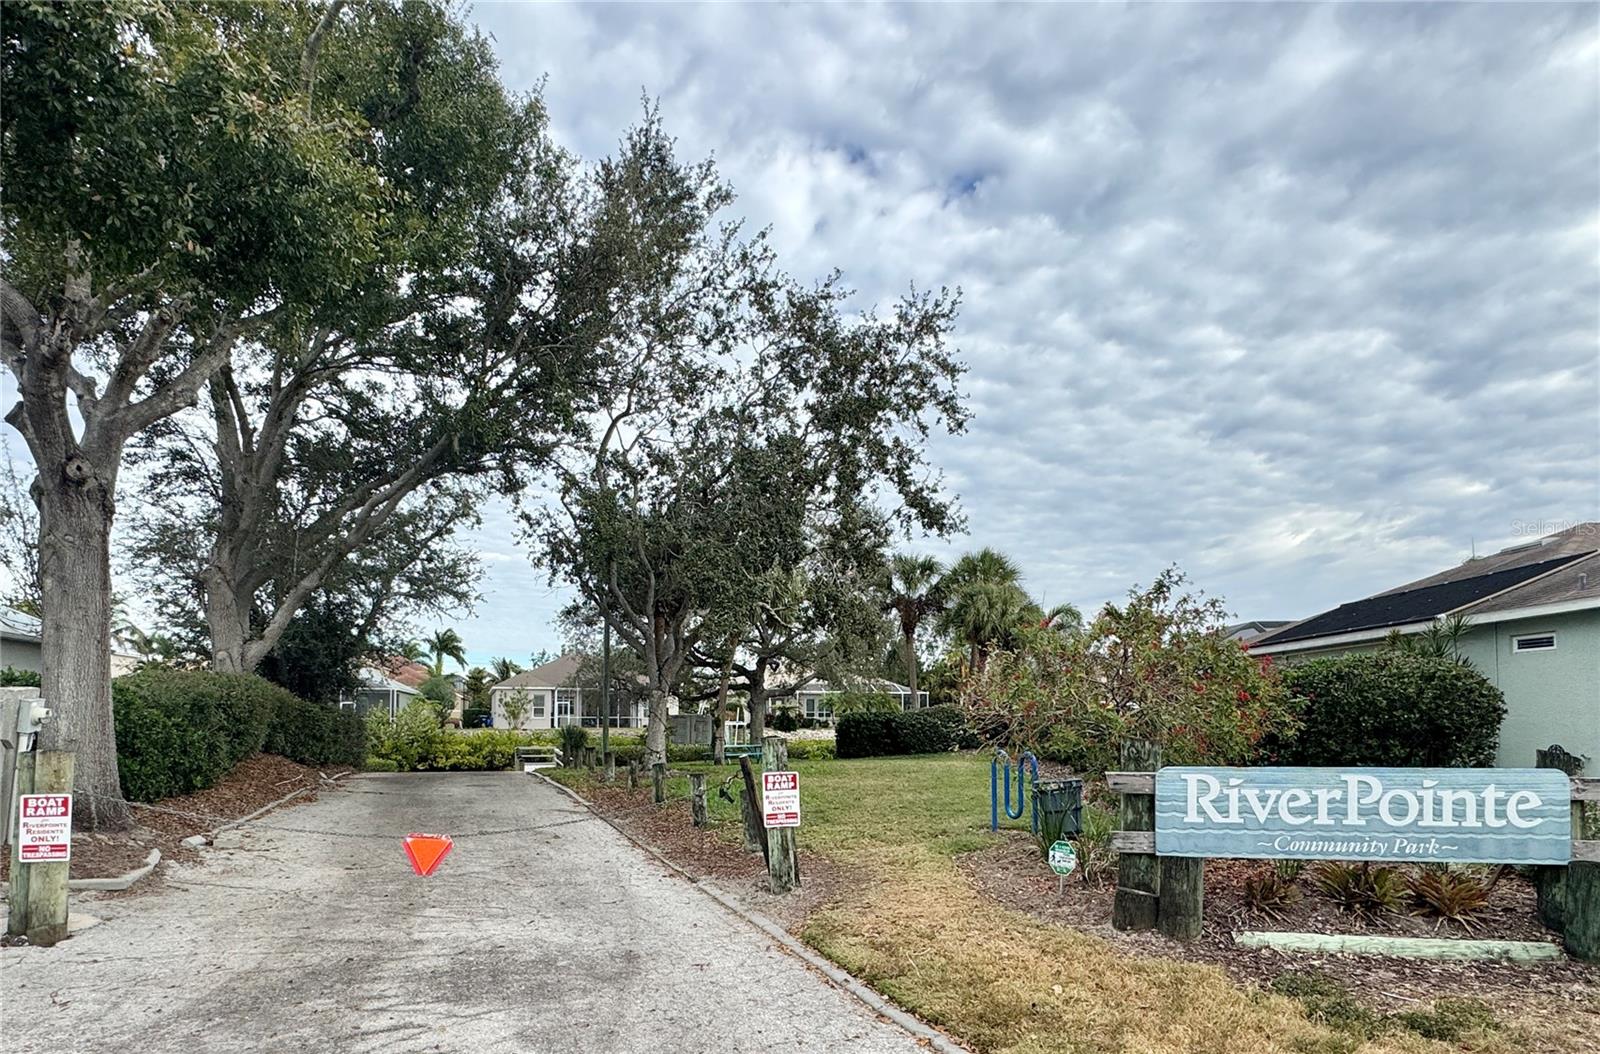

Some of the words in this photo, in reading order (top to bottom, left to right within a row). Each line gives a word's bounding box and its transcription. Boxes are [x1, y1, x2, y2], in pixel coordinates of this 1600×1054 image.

[767, 775, 794, 783] BOAT
[766, 782, 795, 790] RAMP
[27, 798, 65, 807] BOAT
[1180, 773, 1544, 828] RiverPointe
[26, 806, 66, 816] RAMP
